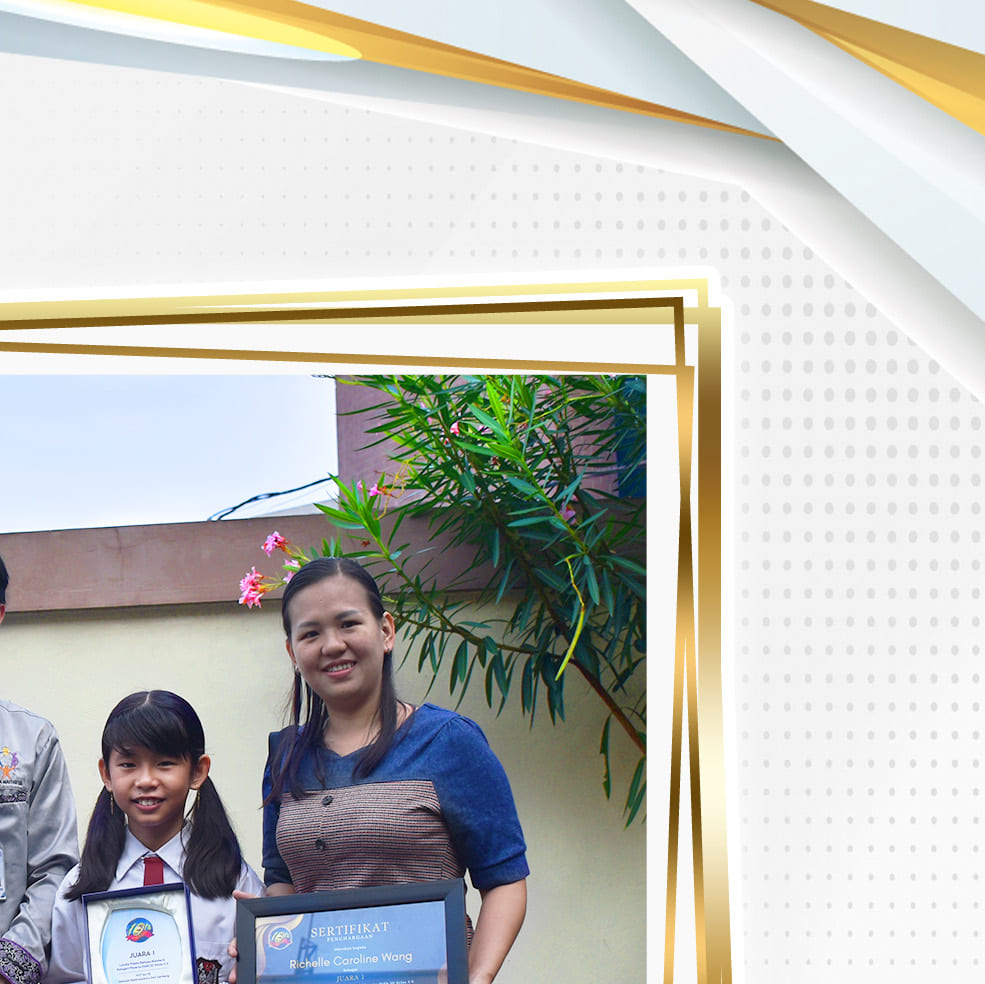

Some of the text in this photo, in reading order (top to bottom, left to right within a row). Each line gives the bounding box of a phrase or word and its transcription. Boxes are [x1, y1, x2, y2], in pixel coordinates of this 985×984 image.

[310, 921, 390, 938] SERTIFIKAT
[129, 950, 151, 959] JUARA
[289, 951, 413, 970] Richelle Caroline Wang
[336, 975, 359, 983] JUARA
